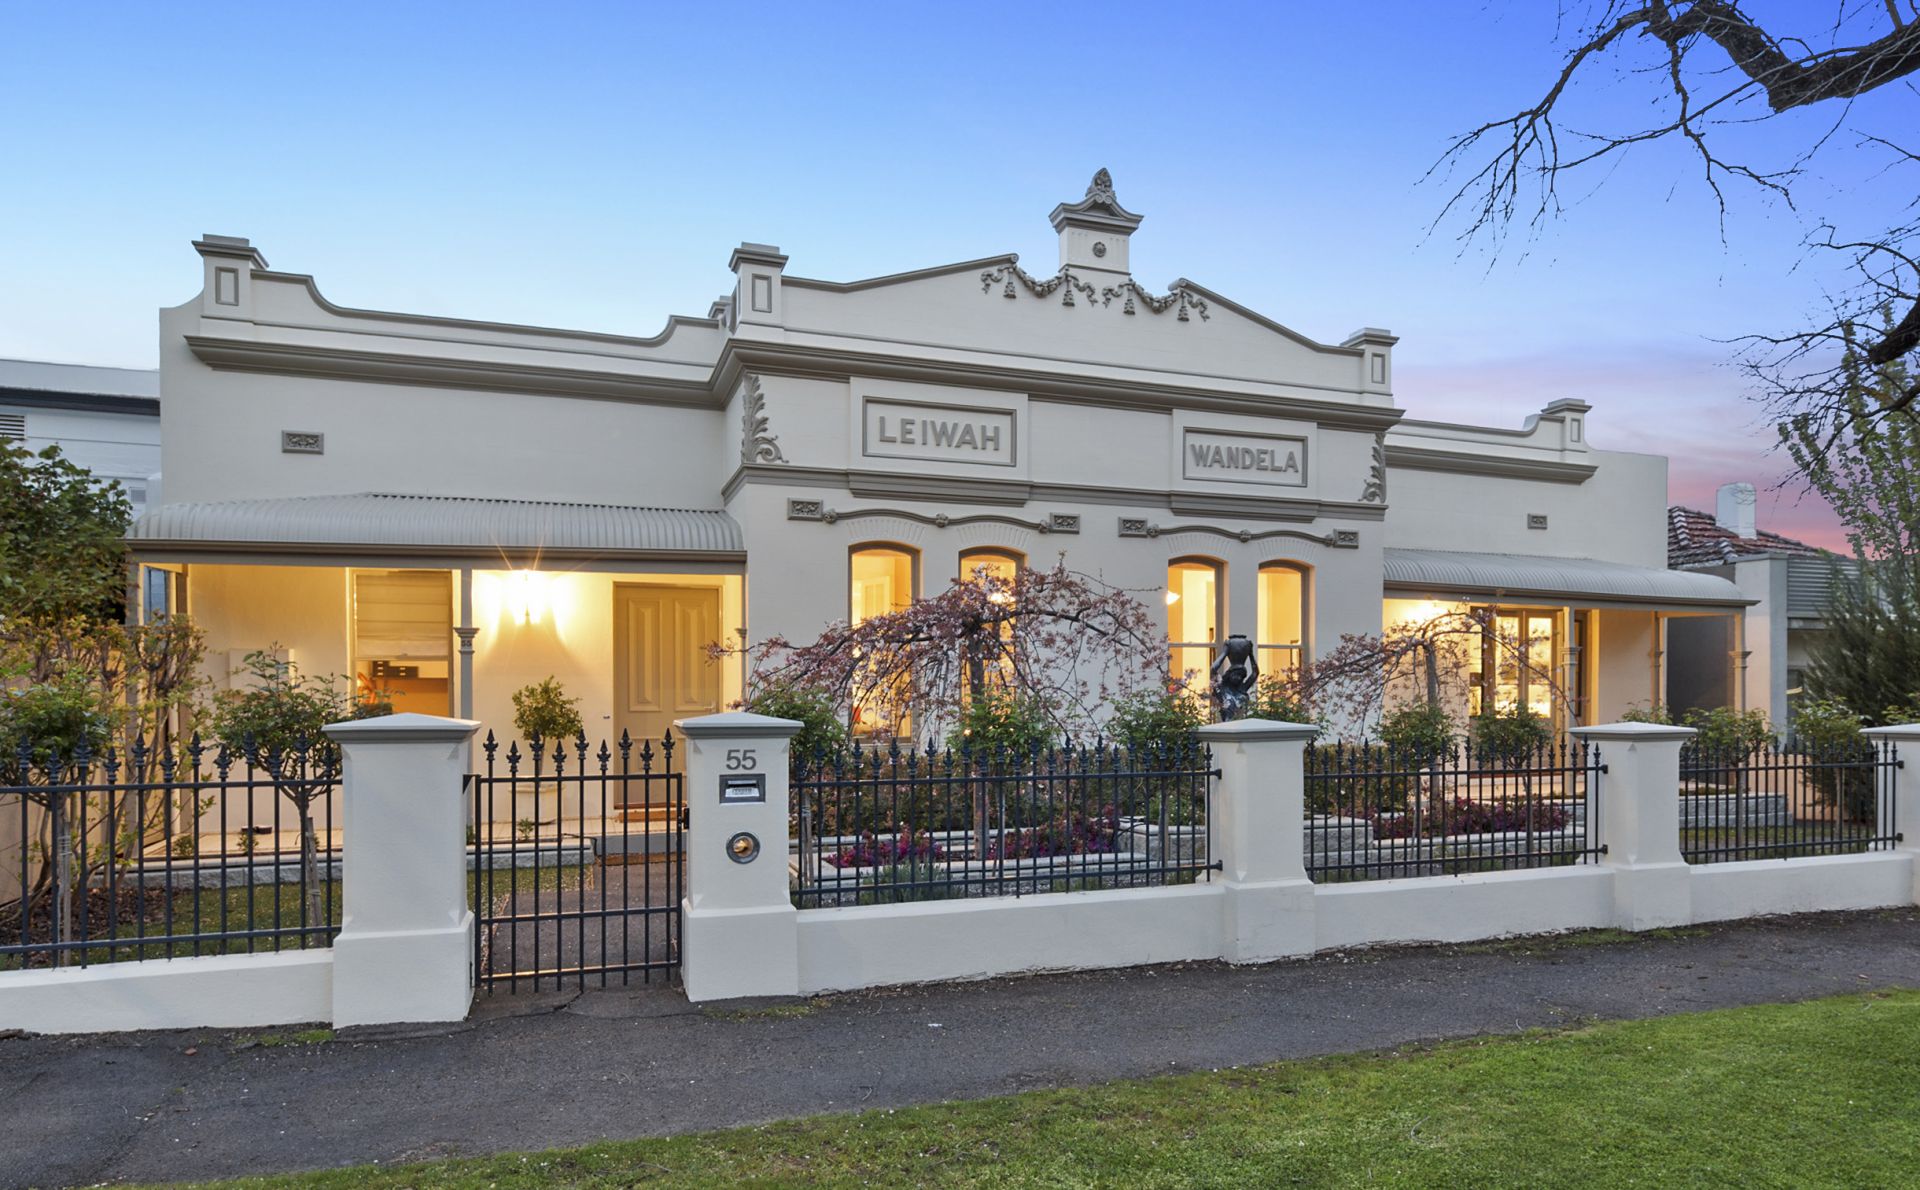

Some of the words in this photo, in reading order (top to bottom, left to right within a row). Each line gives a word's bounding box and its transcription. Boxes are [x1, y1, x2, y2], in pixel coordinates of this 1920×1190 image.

[879, 416, 1000, 451] LEIWAH
[1190, 444, 1299, 473] WANDELA
[726, 749, 757, 770] 55
